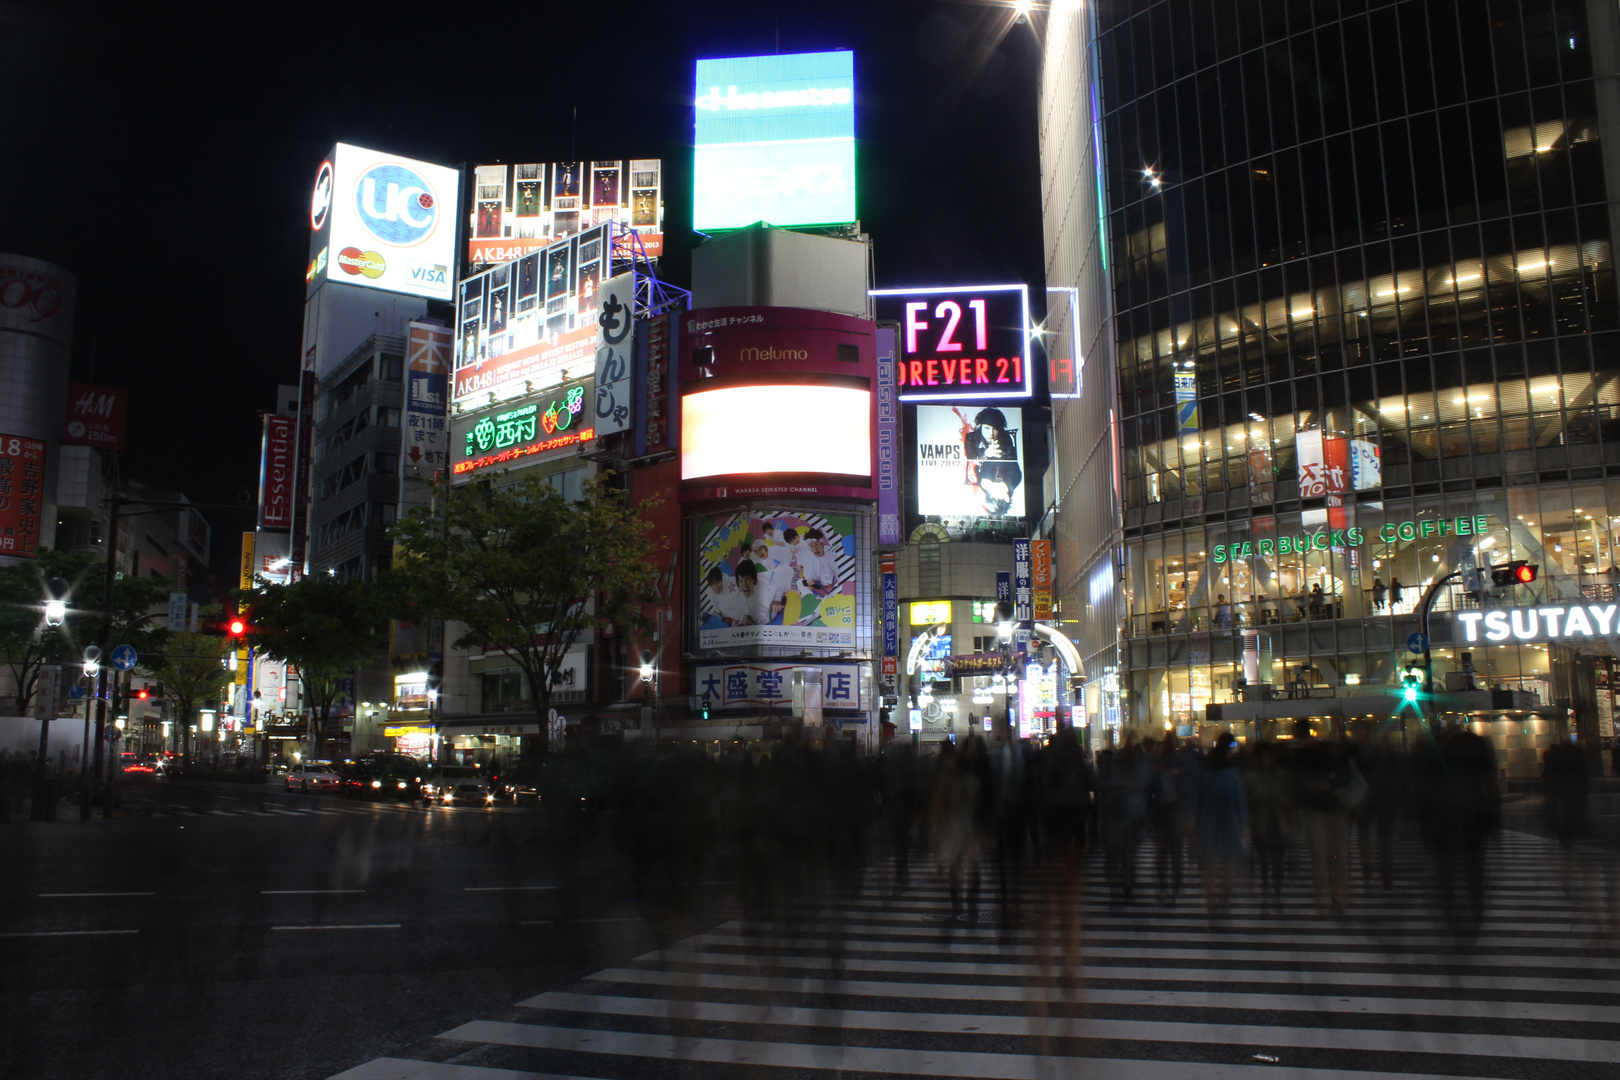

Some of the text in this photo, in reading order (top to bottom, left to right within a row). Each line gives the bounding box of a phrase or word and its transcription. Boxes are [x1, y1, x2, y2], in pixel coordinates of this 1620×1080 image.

[339, 255, 385, 271] MasterCard
[473, 246, 522, 261] AKB48
[411, 267, 446, 284] VISA
[0, 277, 61, 322] 09
[696, 314, 764, 331] わかさ生活 チャンネル
[905, 298, 987, 354] F21
[410, 332, 450, 373] 本
[595, 293, 631, 427] もんじゃ
[456, 370, 493, 397] AKB48
[557, 349, 584, 364] RELEASE
[995, 357, 1022, 385] 21
[74, 391, 115, 419] H&M
[878, 350, 895, 490] Taisei neon
[87, 423, 110, 432] この先
[87, 428, 117, 444] 150m
[408, 415, 444, 431] 夜11時
[415, 430, 437, 444] まで
[496, 416, 536, 448] 西村
[424, 449, 444, 464] 地下
[920, 444, 960, 459] VAMPS
[265, 418, 289, 521] Essential
[16, 461, 39, 554] 吉野家史上
[1213, 515, 1489, 564] STARBUCKS COFFEE
[1016, 543, 1030, 621] 洋服の青山
[885, 578, 896, 651] 大盛堂商事ビル
[1458, 604, 1620, 642] TSUTAY
[954, 656, 1015, 669] バスケットボールストト
[702, 670, 851, 701] 大盛堂店
